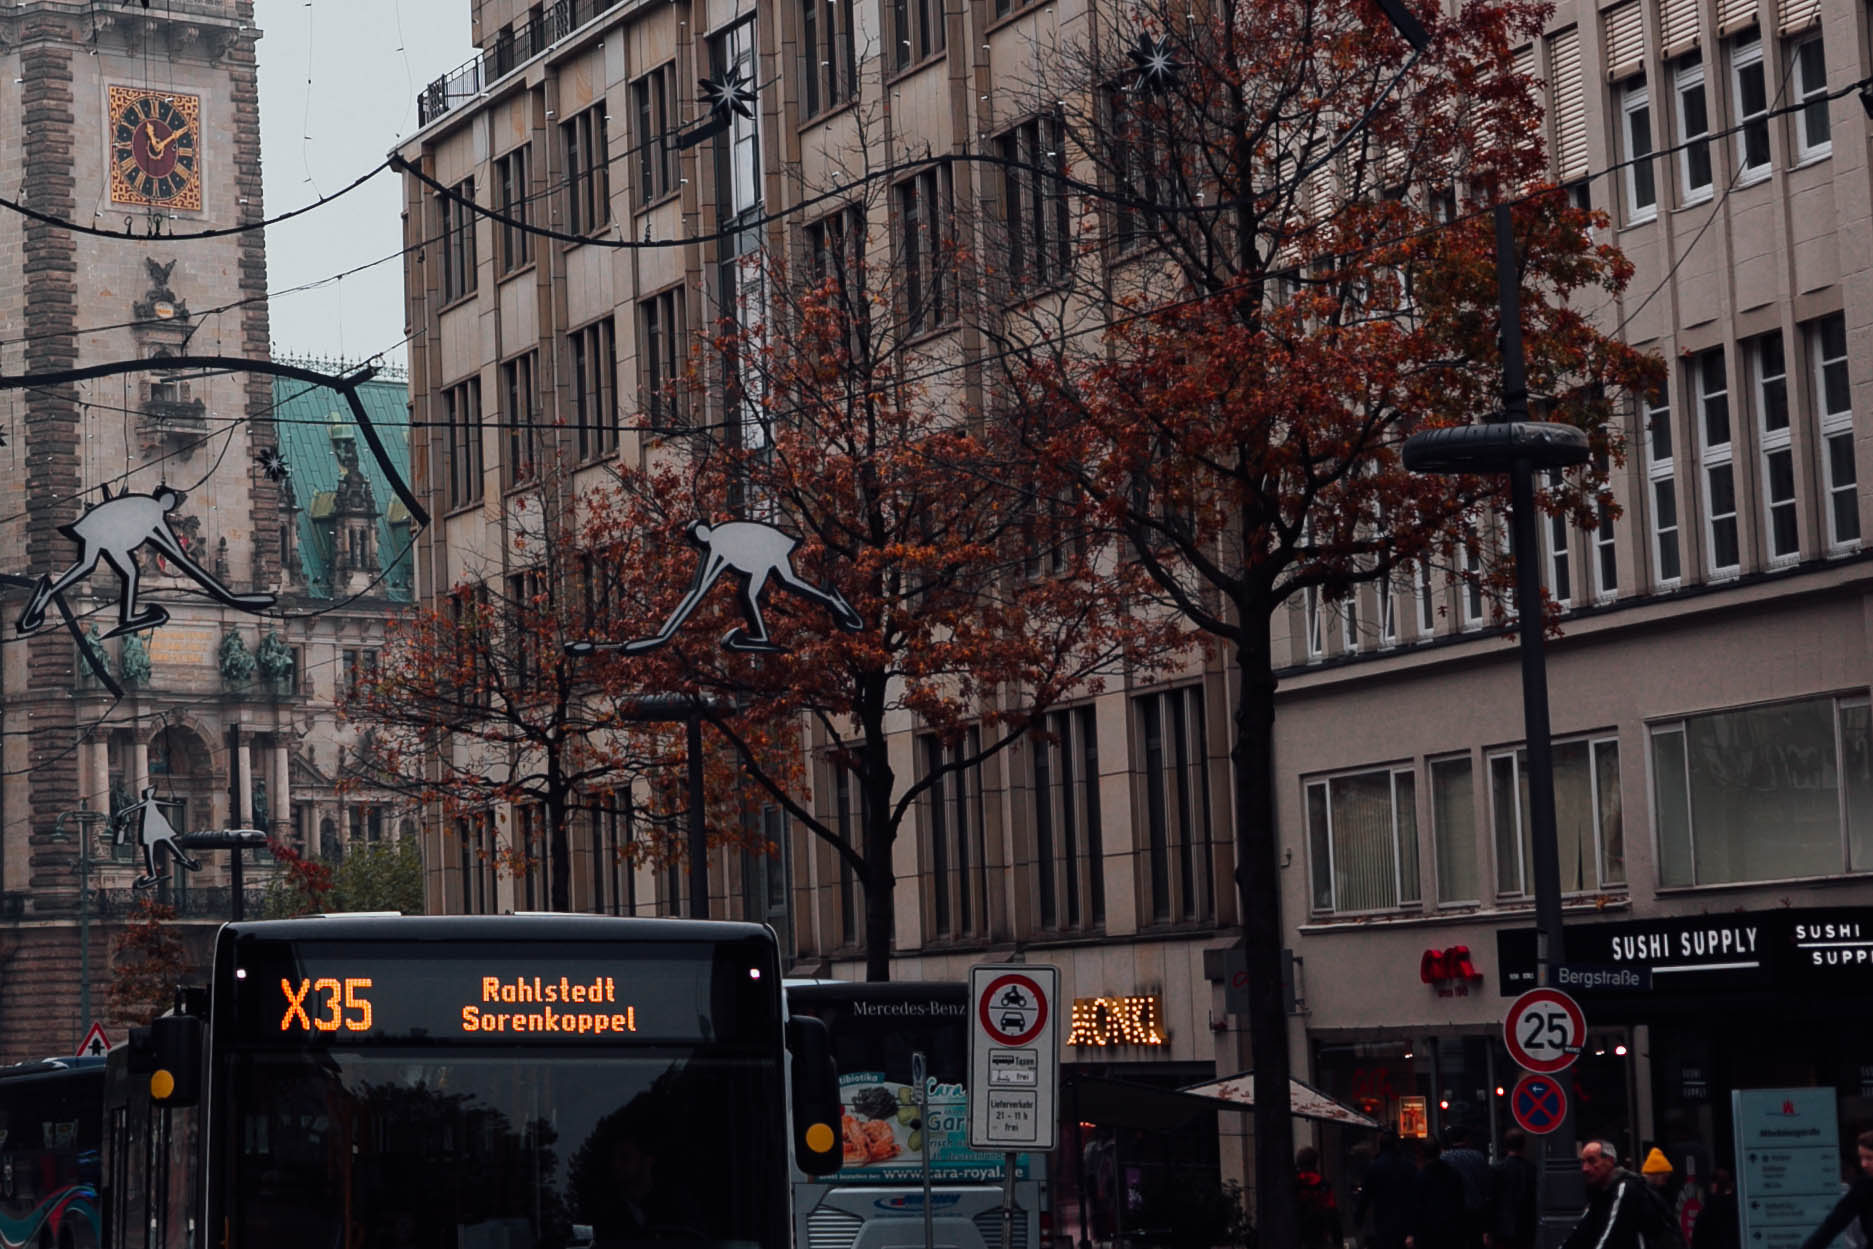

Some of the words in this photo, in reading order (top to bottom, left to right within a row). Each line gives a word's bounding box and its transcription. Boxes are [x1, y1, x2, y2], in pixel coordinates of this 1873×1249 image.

[1795, 923, 1861, 940] SUSHI
[1611, 933, 1670, 961] SUSHI
[1680, 927, 1758, 957] SUPPLY
[1558, 967, 1641, 988] Bergstraße
[481, 976, 616, 1004] Rahlstedt
[280, 977, 373, 1032] X35
[853, 1000, 967, 1017] Mercedes-Benz
[461, 1005, 637, 1035] Sorenkoppel
[1524, 1012, 1568, 1049] 25
[1015, 1056, 1035, 1065] Taxen
[990, 1099, 1033, 1109] Lieferverkehr
[996, 1111, 1005, 1120] 21
[1014, 1111, 1021, 1120] 11
[1004, 1123, 1018, 1132] frei
